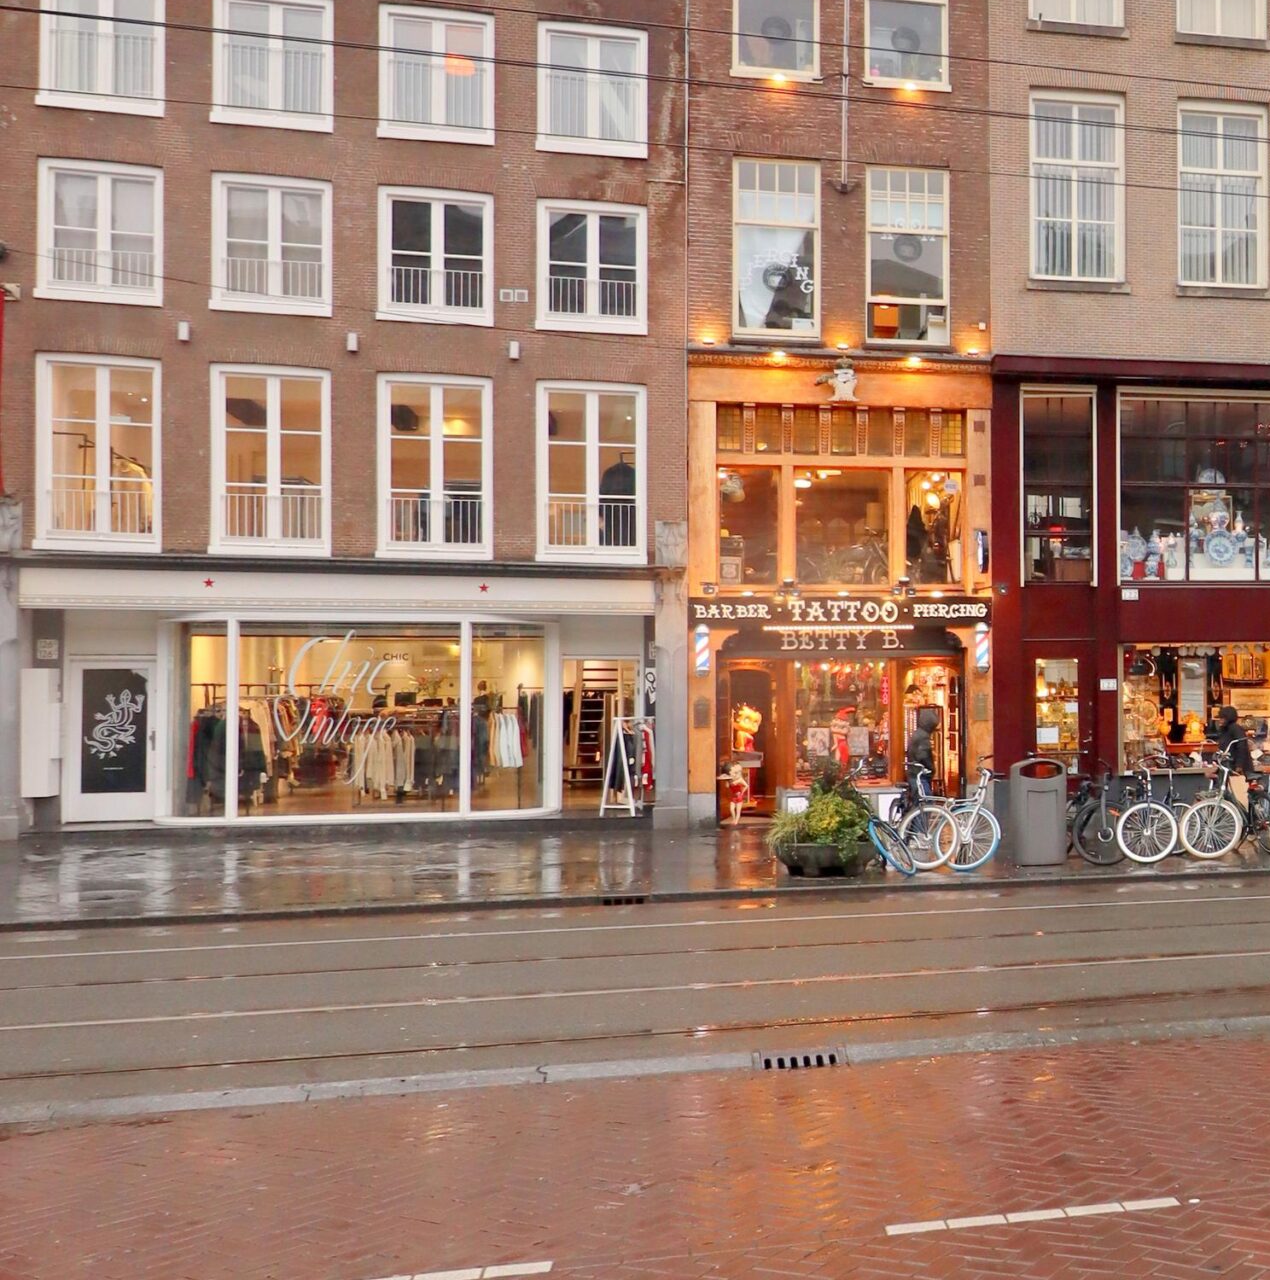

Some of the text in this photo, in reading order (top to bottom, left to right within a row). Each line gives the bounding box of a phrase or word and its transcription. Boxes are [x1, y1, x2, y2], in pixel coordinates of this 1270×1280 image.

[694, 600, 988, 623] BARBER TATTOO PIERCING
[780, 629, 872, 650] BETTY
[287, 629, 389, 697] Chic
[382, 652, 410, 662] CHIC
[273, 695, 397, 785] Vintage
